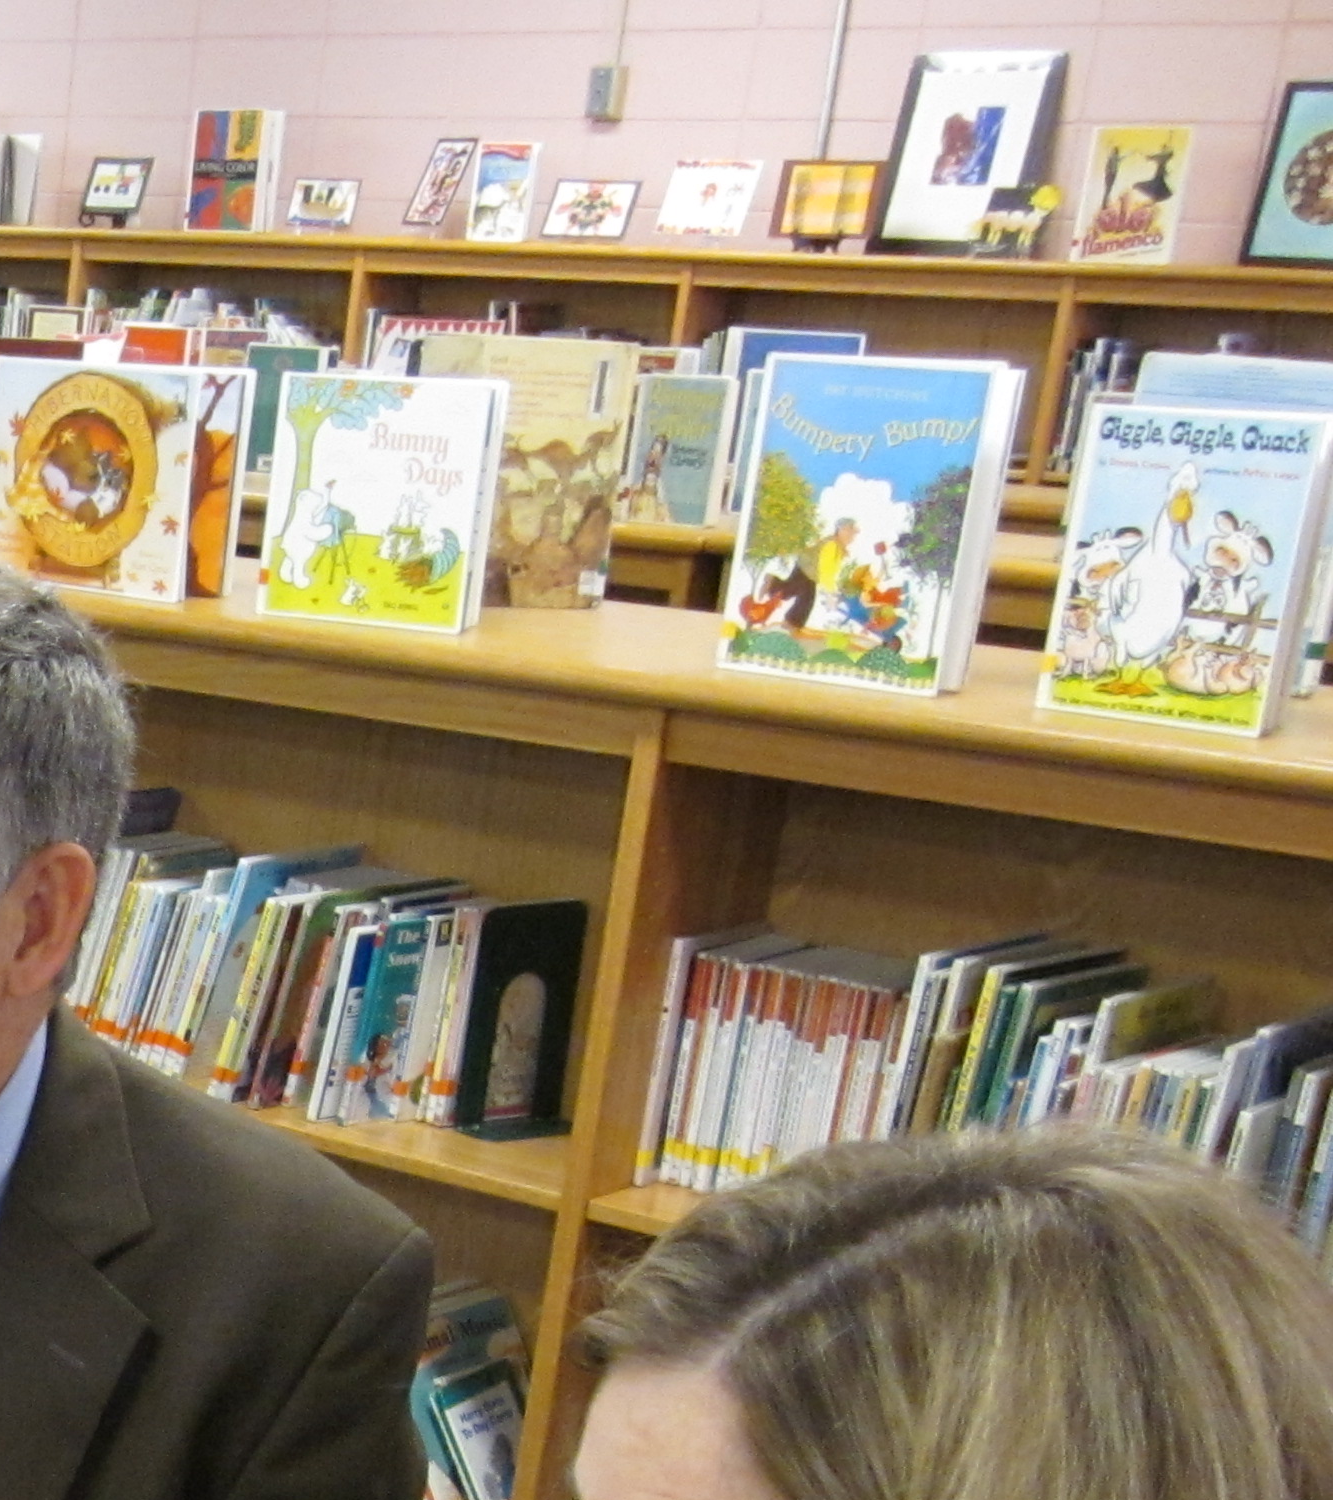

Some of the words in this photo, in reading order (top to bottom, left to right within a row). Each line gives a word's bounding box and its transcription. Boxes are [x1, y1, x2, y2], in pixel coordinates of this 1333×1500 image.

[368, 422, 450, 464] Bunny
[882, 417, 980, 447] Bump!
[1100, 416, 1164, 450] Giggle,
[1170, 421, 1236, 454] Giggle,
[1241, 425, 1312, 454] Quack
[406, 456, 464, 498] Days
[396, 929, 421, 944] The
